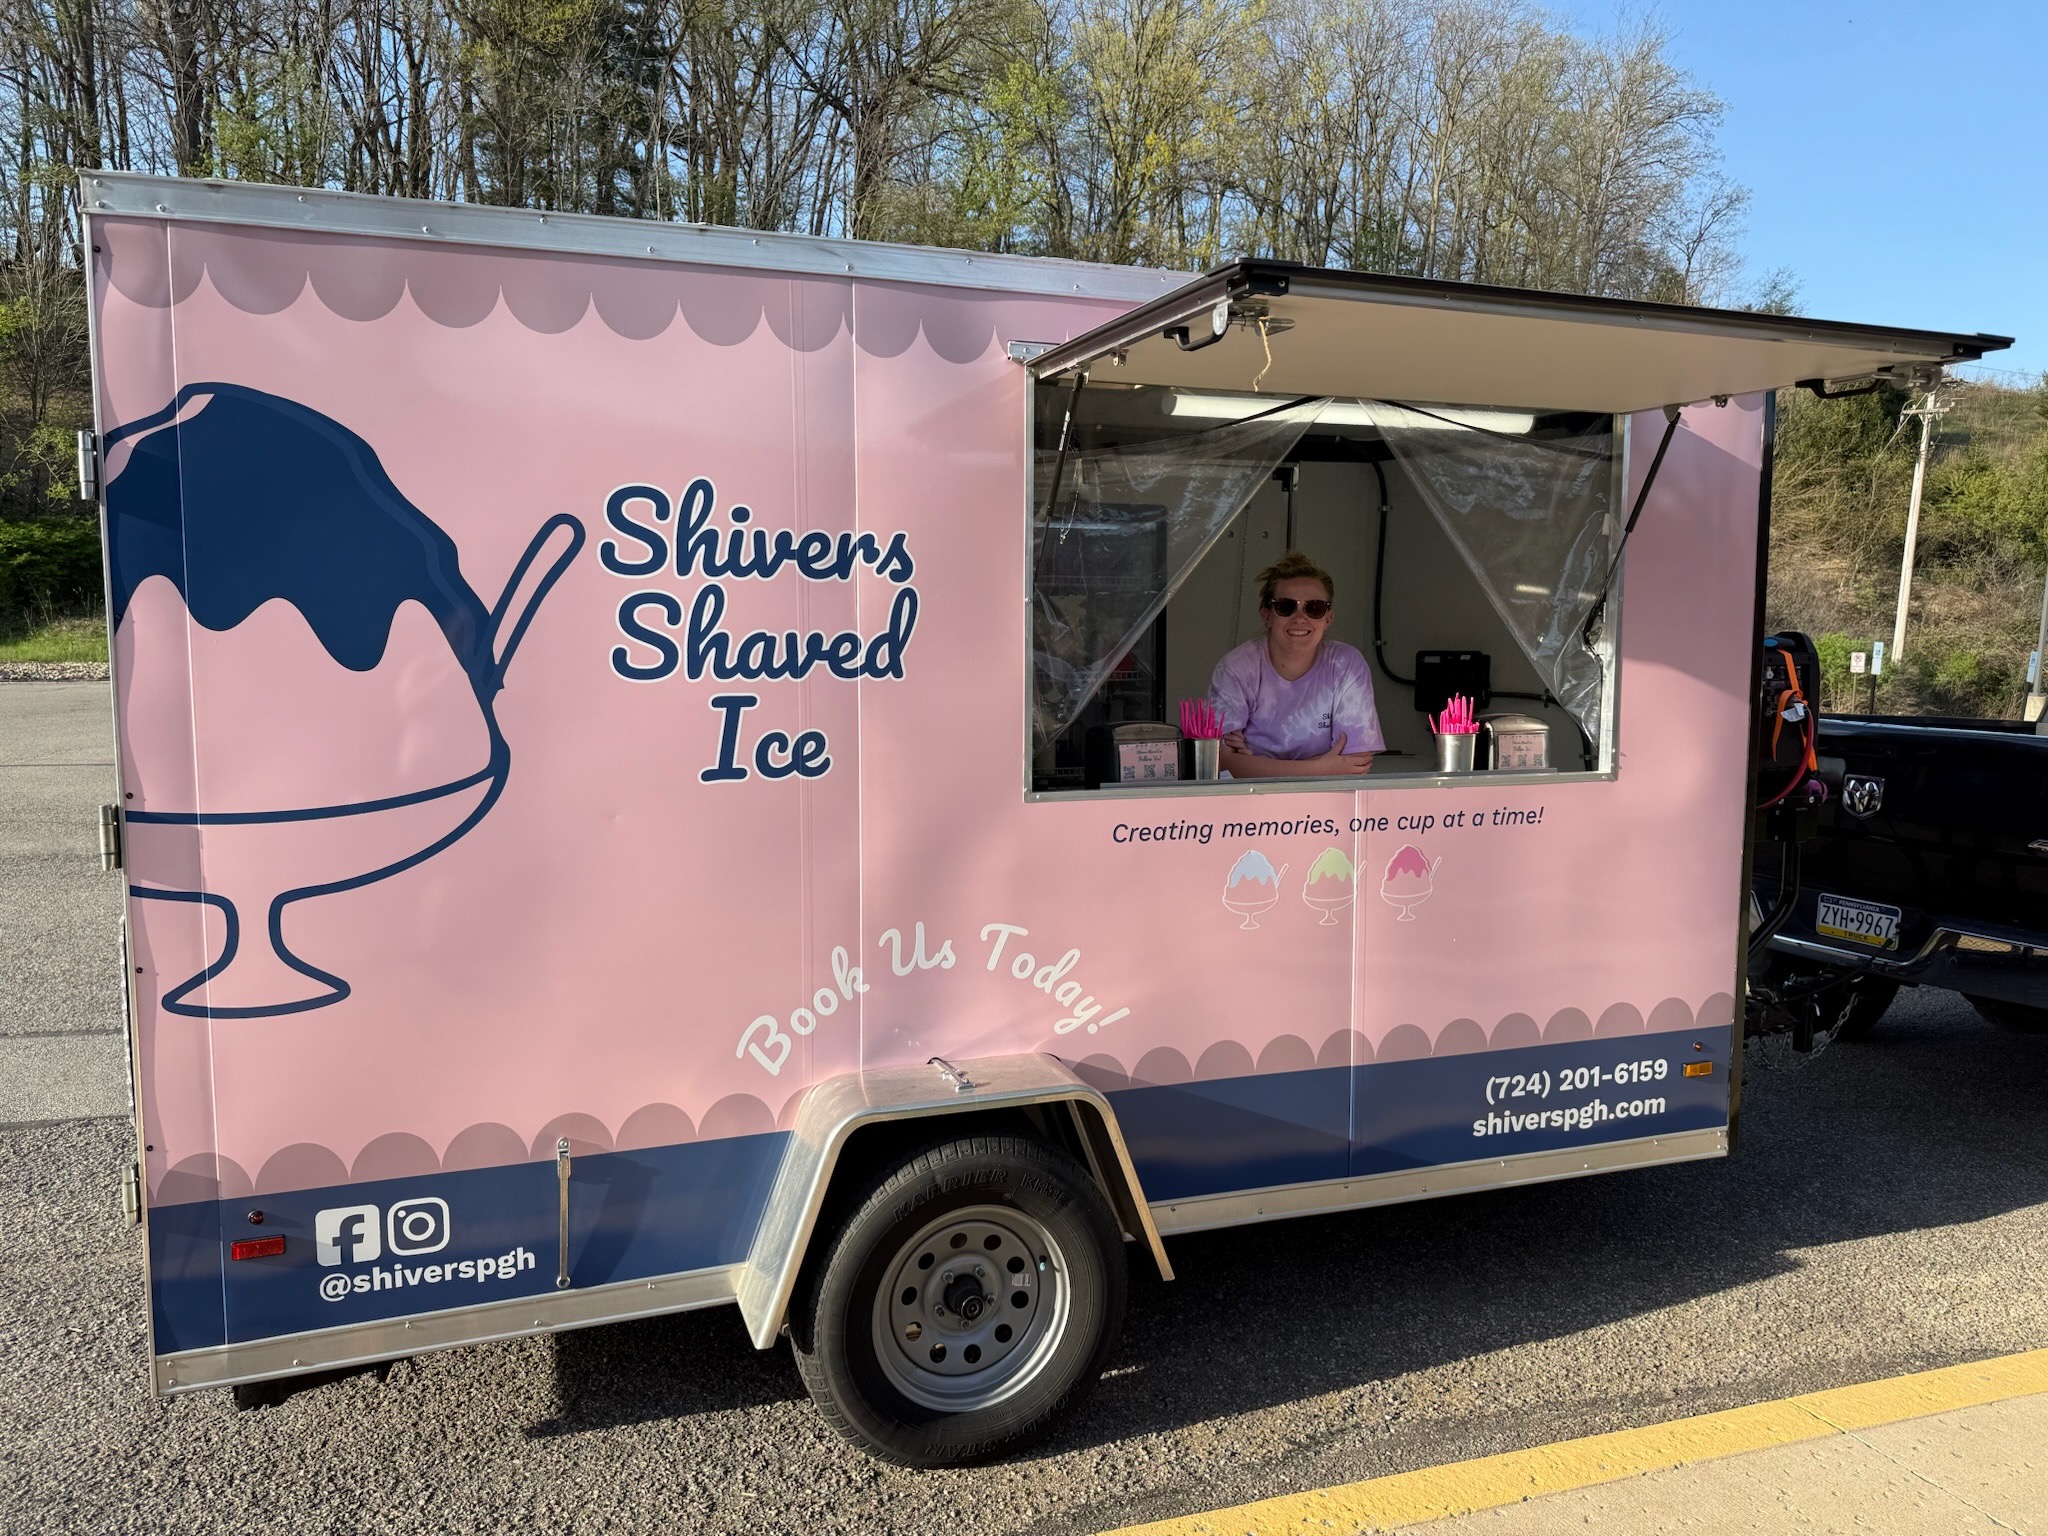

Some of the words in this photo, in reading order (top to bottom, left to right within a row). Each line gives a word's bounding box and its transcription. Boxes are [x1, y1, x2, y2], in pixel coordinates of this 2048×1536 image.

[598, 476, 915, 583] Shivers
[610, 582, 919, 681] Shaved
[699, 694, 832, 783] Ice
[1112, 819, 1214, 845] Creating
[1221, 814, 1340, 838] memories,
[1349, 816, 1389, 833] one
[1397, 814, 1435, 834] cup
[1442, 810, 1465, 828] at
[1472, 812, 1485, 826] a
[1492, 806, 1544, 826] time!
[1844, 930, 1869, 941] TRUCK
[735, 945, 870, 1076] Book
[879, 921, 957, 977] Us
[980, 922, 1131, 1035] Today!
[1485, 1069, 1551, 1105] (724)
[1559, 1058, 1669, 1092] 201-6159
[1472, 1096, 1667, 1137] shiverspgh.com
[892, 1168, 1009, 1223] KARRIER
[319, 1246, 536, 1302] @shiverspgh
